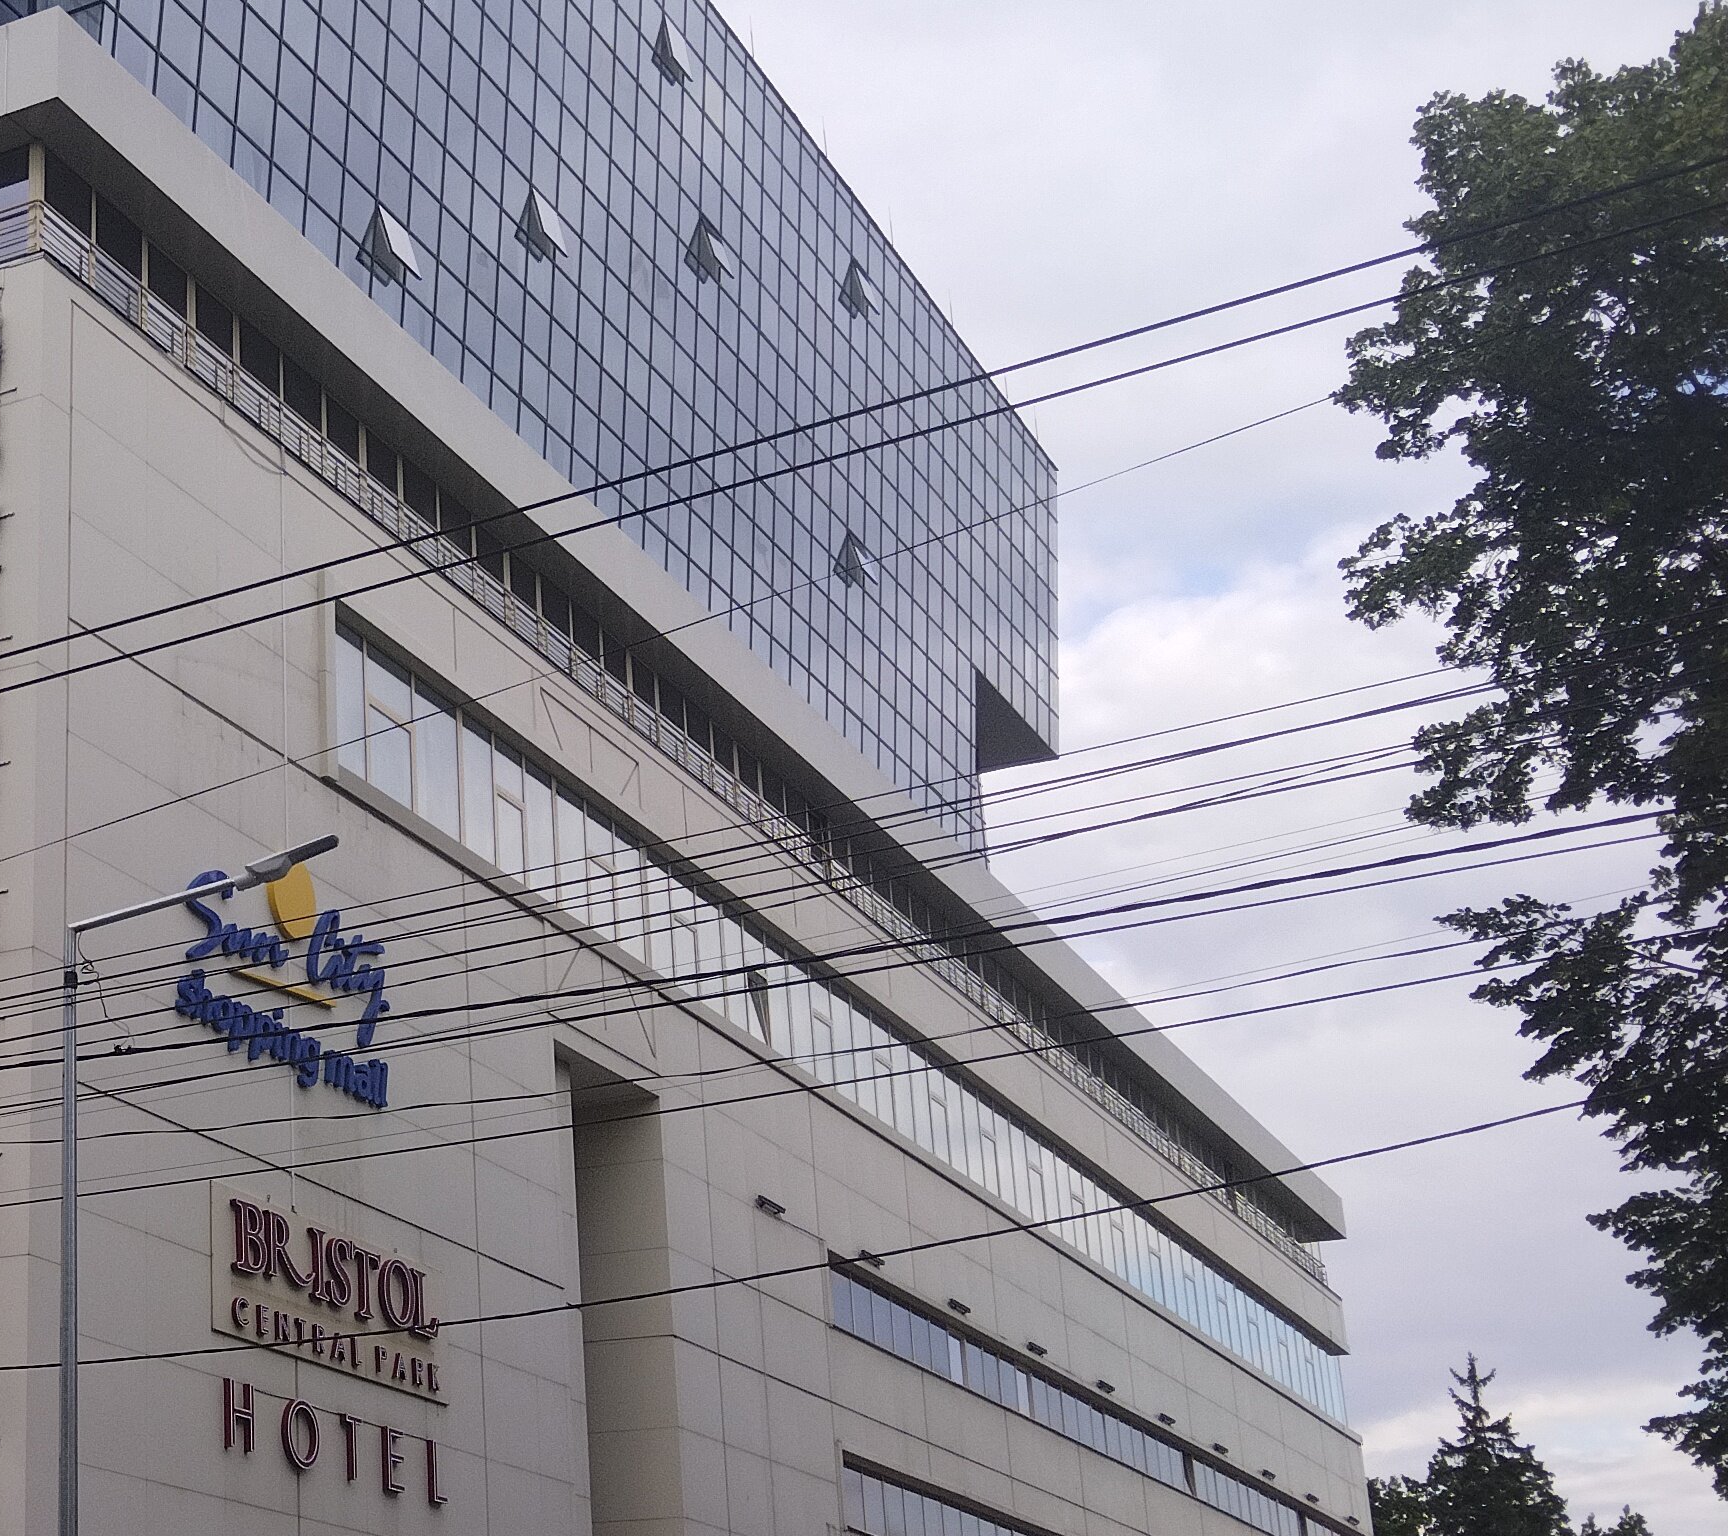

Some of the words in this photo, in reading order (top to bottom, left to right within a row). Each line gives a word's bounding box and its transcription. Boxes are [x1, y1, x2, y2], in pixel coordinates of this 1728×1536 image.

[184, 869, 290, 968] Sun
[306, 909, 390, 1048] City
[323, 1050, 388, 1108] mall
[230, 1198, 439, 1341] BRISTOL
[231, 1297, 363, 1368] CENTRAL
[375, 1345, 440, 1392] PARK
[223, 1378, 448, 1506] HOTEL
